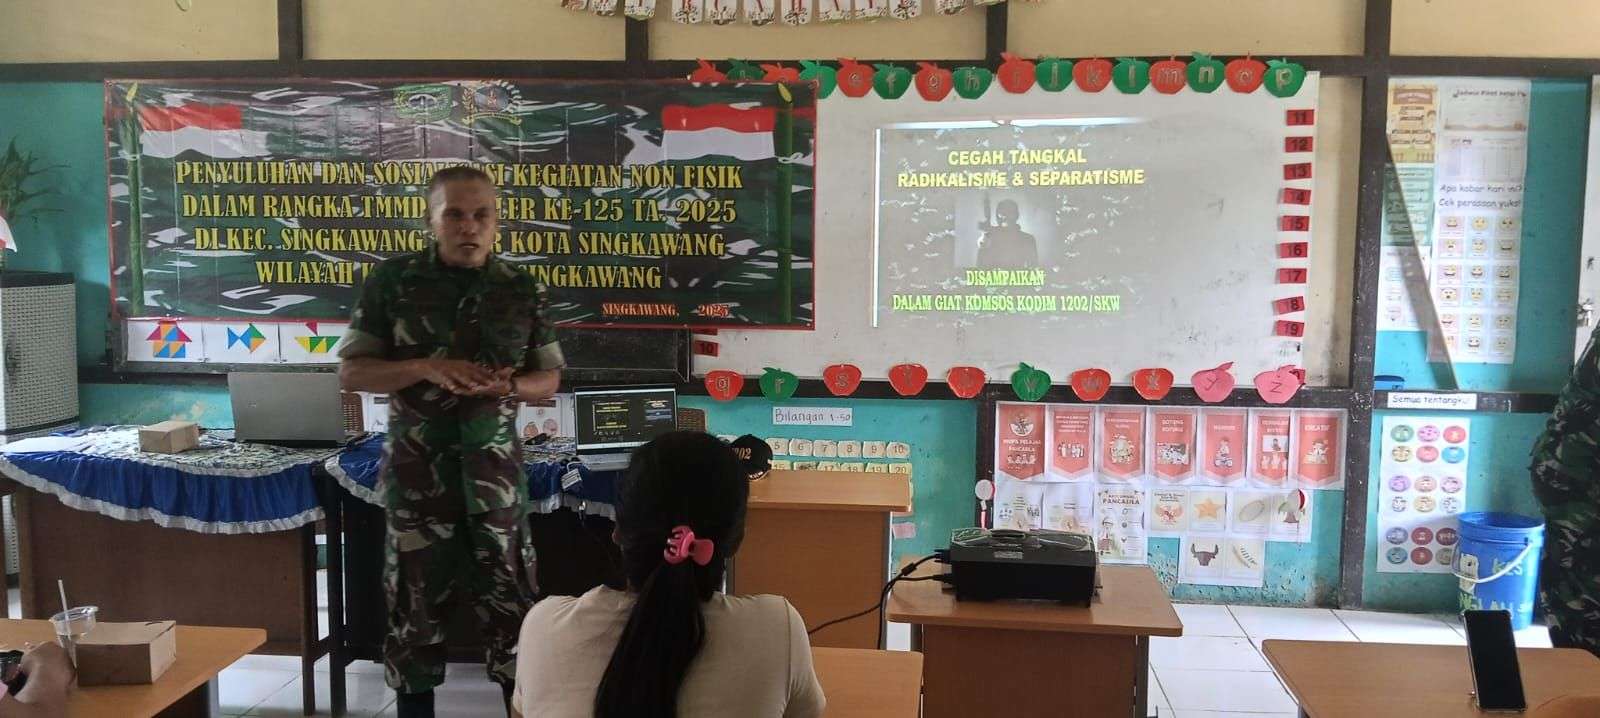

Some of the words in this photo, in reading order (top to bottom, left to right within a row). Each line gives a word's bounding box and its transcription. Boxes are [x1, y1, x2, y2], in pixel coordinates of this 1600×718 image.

[886, 73, 896, 94] f
[966, 71, 980, 90] h
[1158, 68, 1185, 85] m
[1199, 65, 1215, 84] n
[1276, 68, 1293, 91] p
[948, 150, 1004, 165] CEGAH
[1010, 149, 1087, 164] TANGKAL
[176, 161, 313, 185] PENYULUHAN
[321, 162, 366, 186] DAN
[513, 164, 622, 188] KEGIATAN
[630, 165, 675, 188] NON
[684, 165, 743, 189] FISIK
[897, 172, 1007, 187] RADIKALISME
[1012, 171, 1024, 185] &
[1029, 169, 1145, 185] SEPARATISME
[183, 194, 255, 217] DALAM
[263, 195, 353, 218] RANGKA
[361, 196, 427, 219] TMMD
[544, 198, 624, 222] KE-125
[632, 199, 666, 222] TA.
[676, 199, 737, 223] 2025
[195, 228, 219, 250] DI
[226, 228, 272, 251] KEC.
[281, 229, 424, 252] SINGKAWANG
[511, 231, 571, 254] KOTA
[579, 233, 725, 257] SINGKAWANG
[255, 260, 354, 284] WILAYAH
[966, 270, 1045, 286] DISAMPAIKAN
[698, 304, 729, 317] 2025
[893, 295, 931, 310] DALAM
[935, 295, 963, 310] GIAT
[965, 294, 1014, 310] KOMSOS
[1016, 295, 1056, 310] KODIM
[1060, 294, 1121, 311] 1202/SKW
[775, 377, 784, 393] r
[835, 372, 848, 388] s
[1204, 376, 1219, 392] y
[1270, 381, 1283, 394] z
[775, 408, 824, 424] Bilangan
[894, 444, 904, 453] 10
